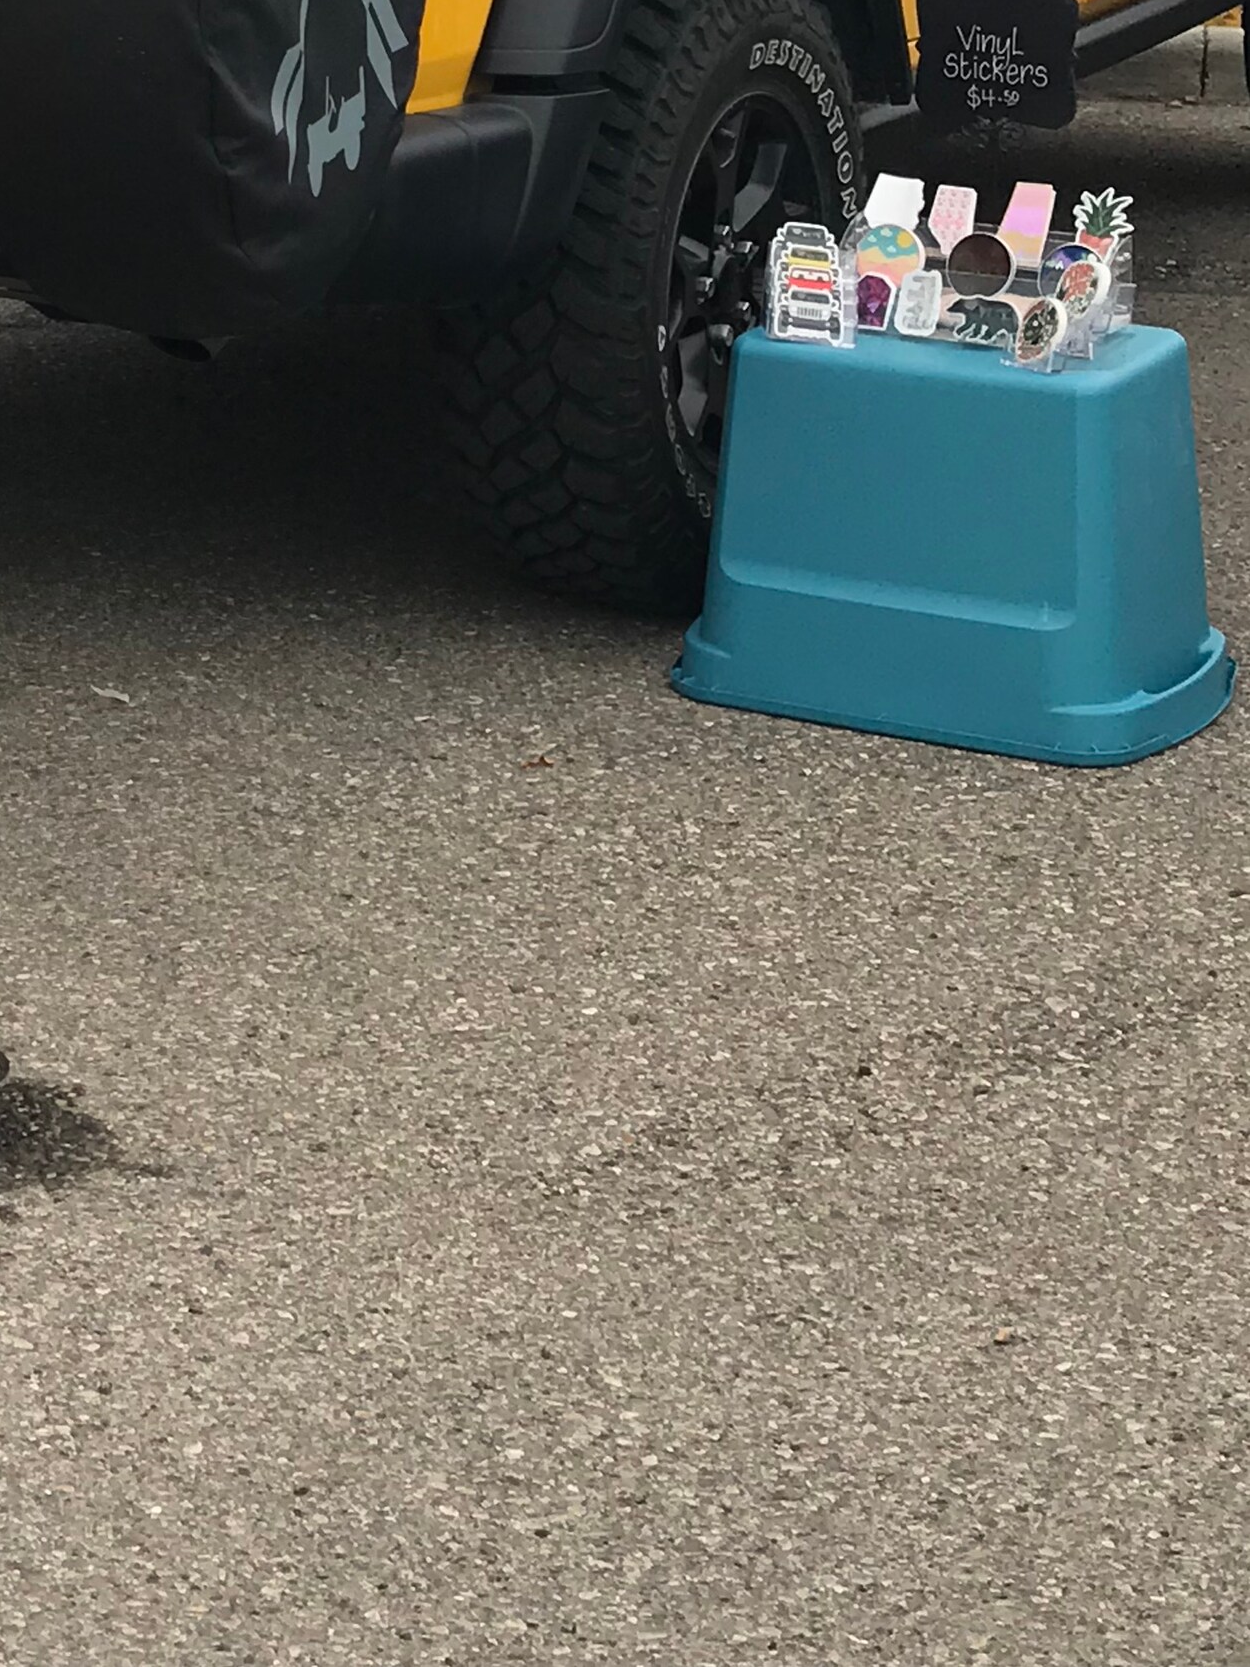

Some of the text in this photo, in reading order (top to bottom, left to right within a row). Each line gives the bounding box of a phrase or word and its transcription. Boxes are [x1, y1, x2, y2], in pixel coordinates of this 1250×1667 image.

[956, 24, 1024, 70] Vinyl
[943, 52, 1049, 88] Stickers
[967, 84, 1020, 110] $4.50
[749, 39, 858, 219] DESTINATION
